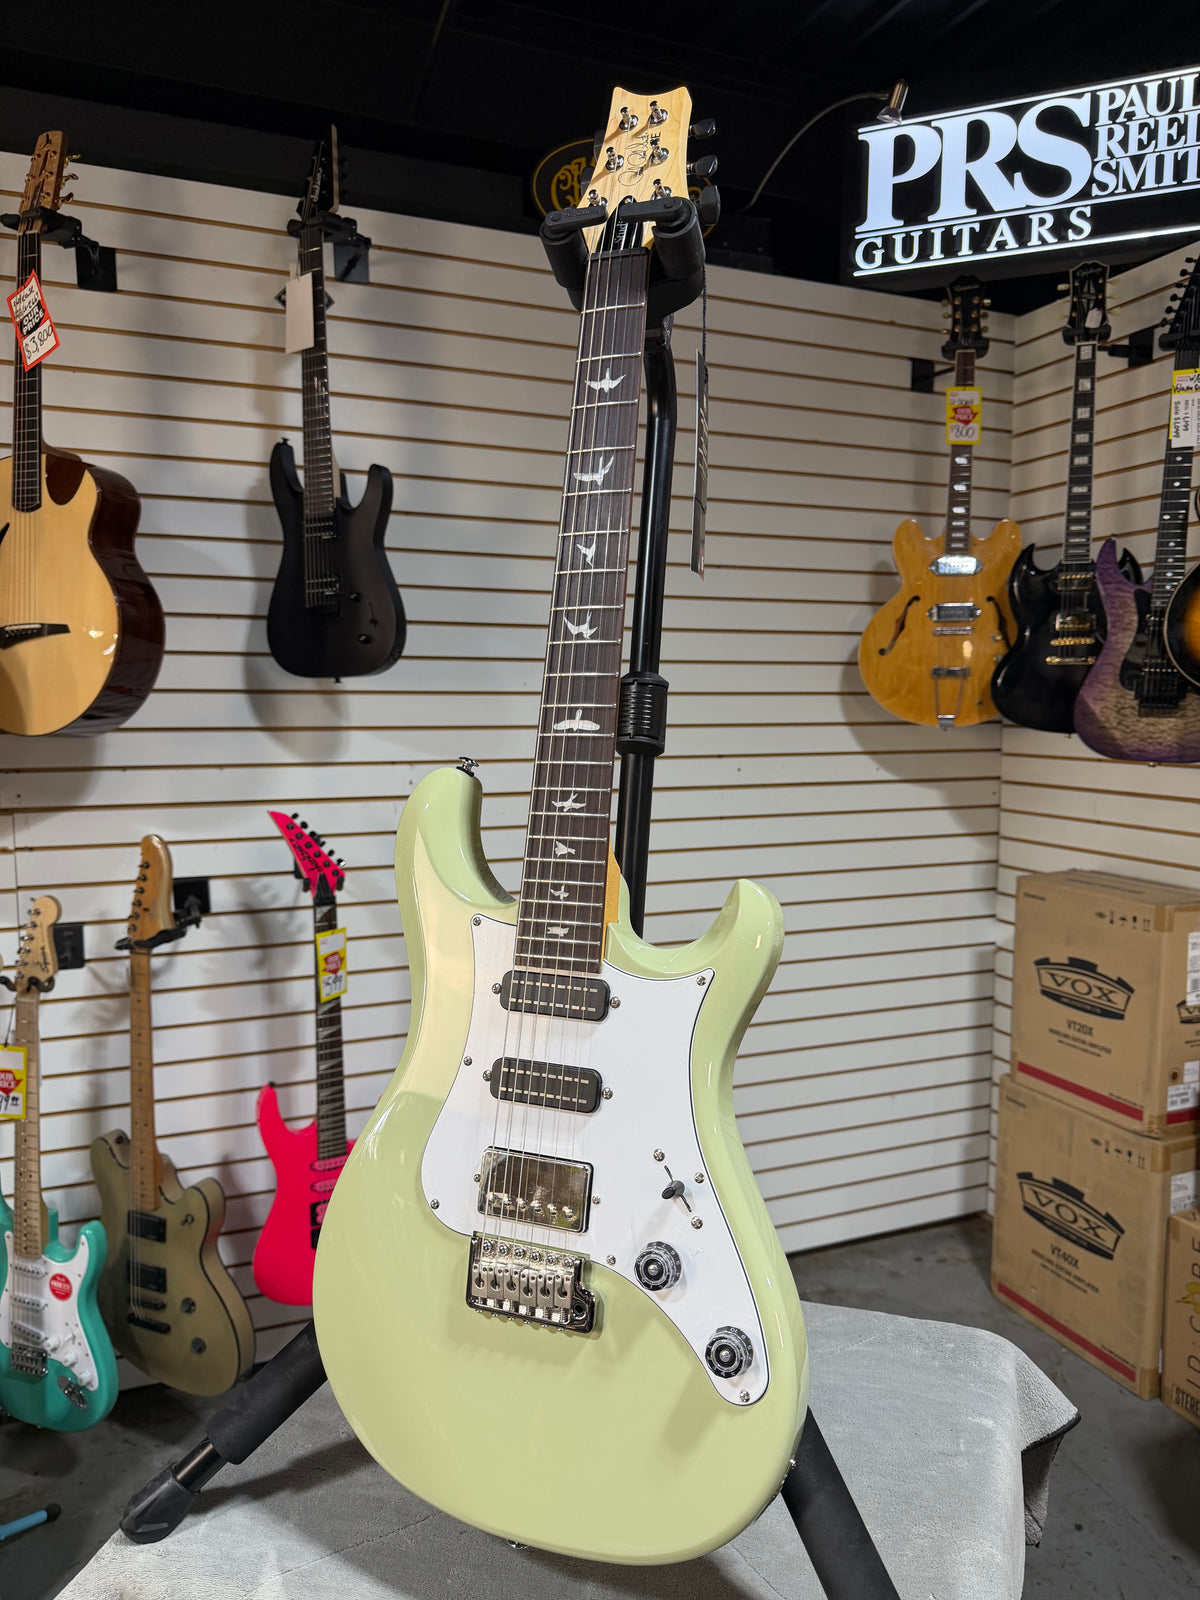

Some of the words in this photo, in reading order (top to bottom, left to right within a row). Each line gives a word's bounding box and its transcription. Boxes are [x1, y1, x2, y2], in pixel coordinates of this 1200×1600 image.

[1095, 73, 1200, 126] PAUL
[855, 93, 1092, 232] PRS
[855, 206, 1092, 270] GUITARS
[23, 305, 39, 324] OUR
[23, 308, 44, 335] PRICE
[24, 325, 54, 359] $3,800
[1046, 971, 1118, 1005] VOX
[1028, 1186, 1108, 1242] VOX
